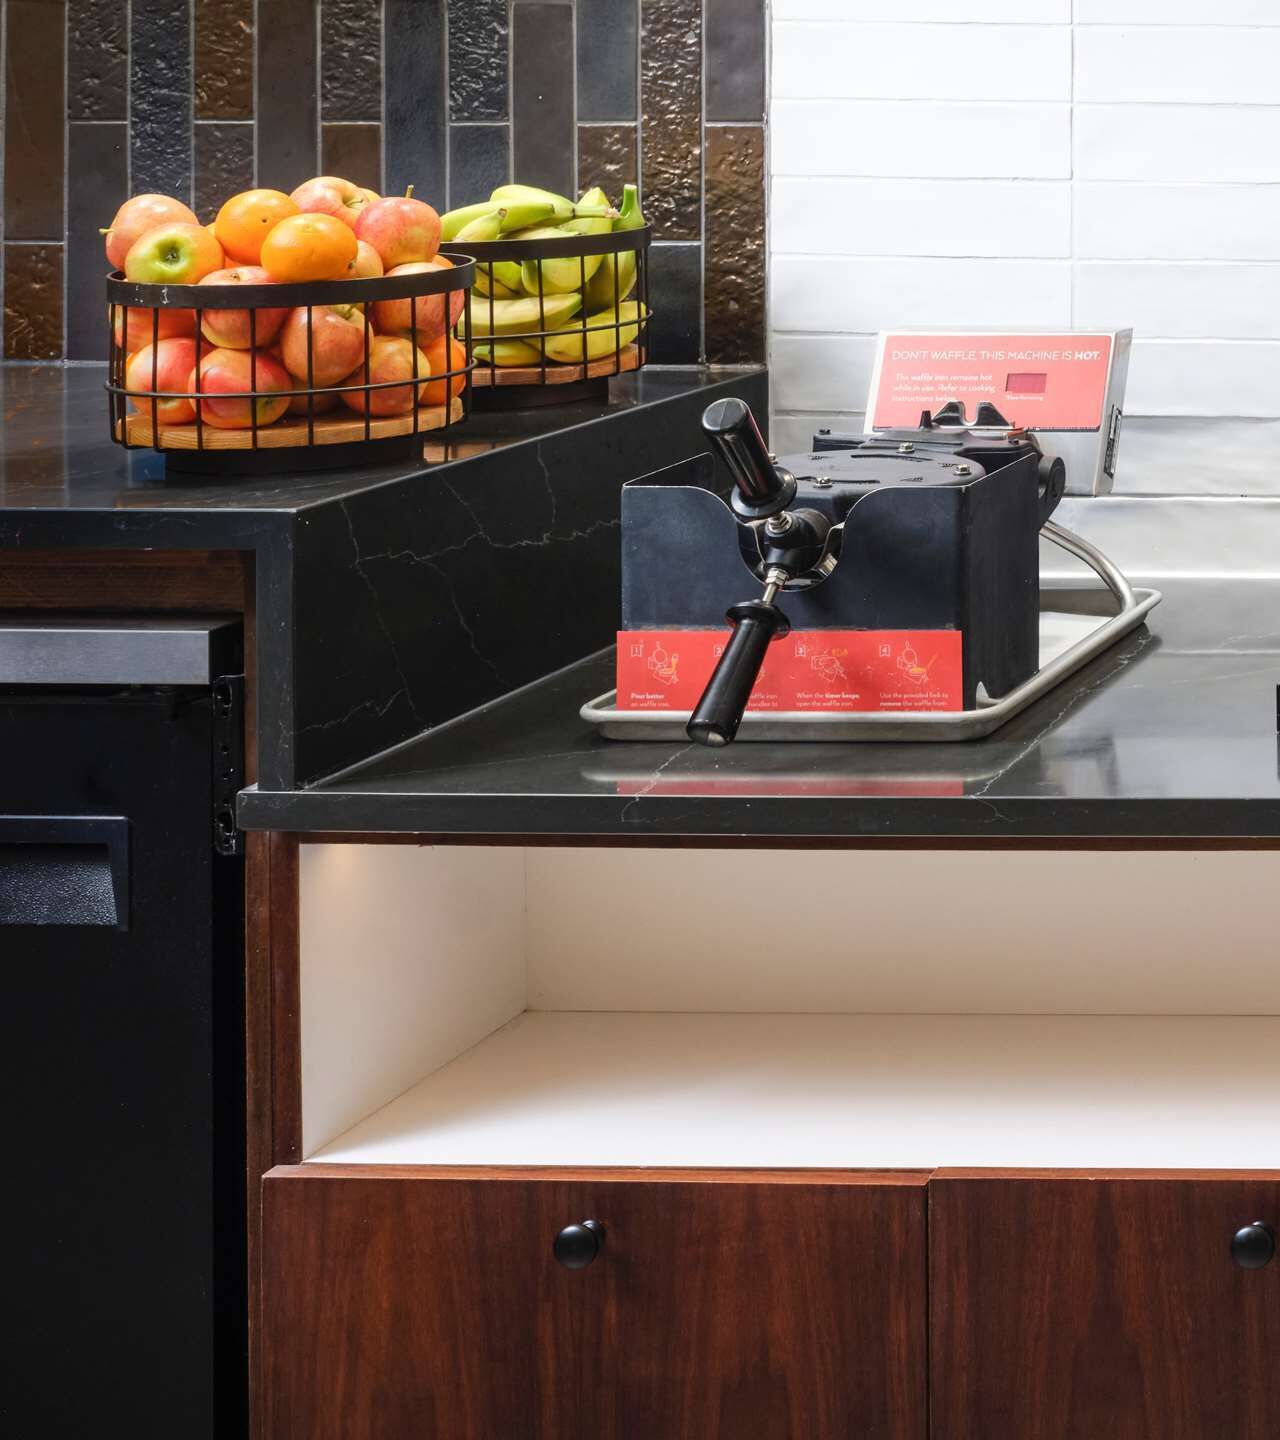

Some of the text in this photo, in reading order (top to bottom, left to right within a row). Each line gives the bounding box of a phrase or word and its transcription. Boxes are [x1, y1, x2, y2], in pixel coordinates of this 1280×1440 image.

[980, 350, 1004, 361] THIS
[1007, 350, 1059, 361] MACHINE
[1061, 350, 1072, 361] IS
